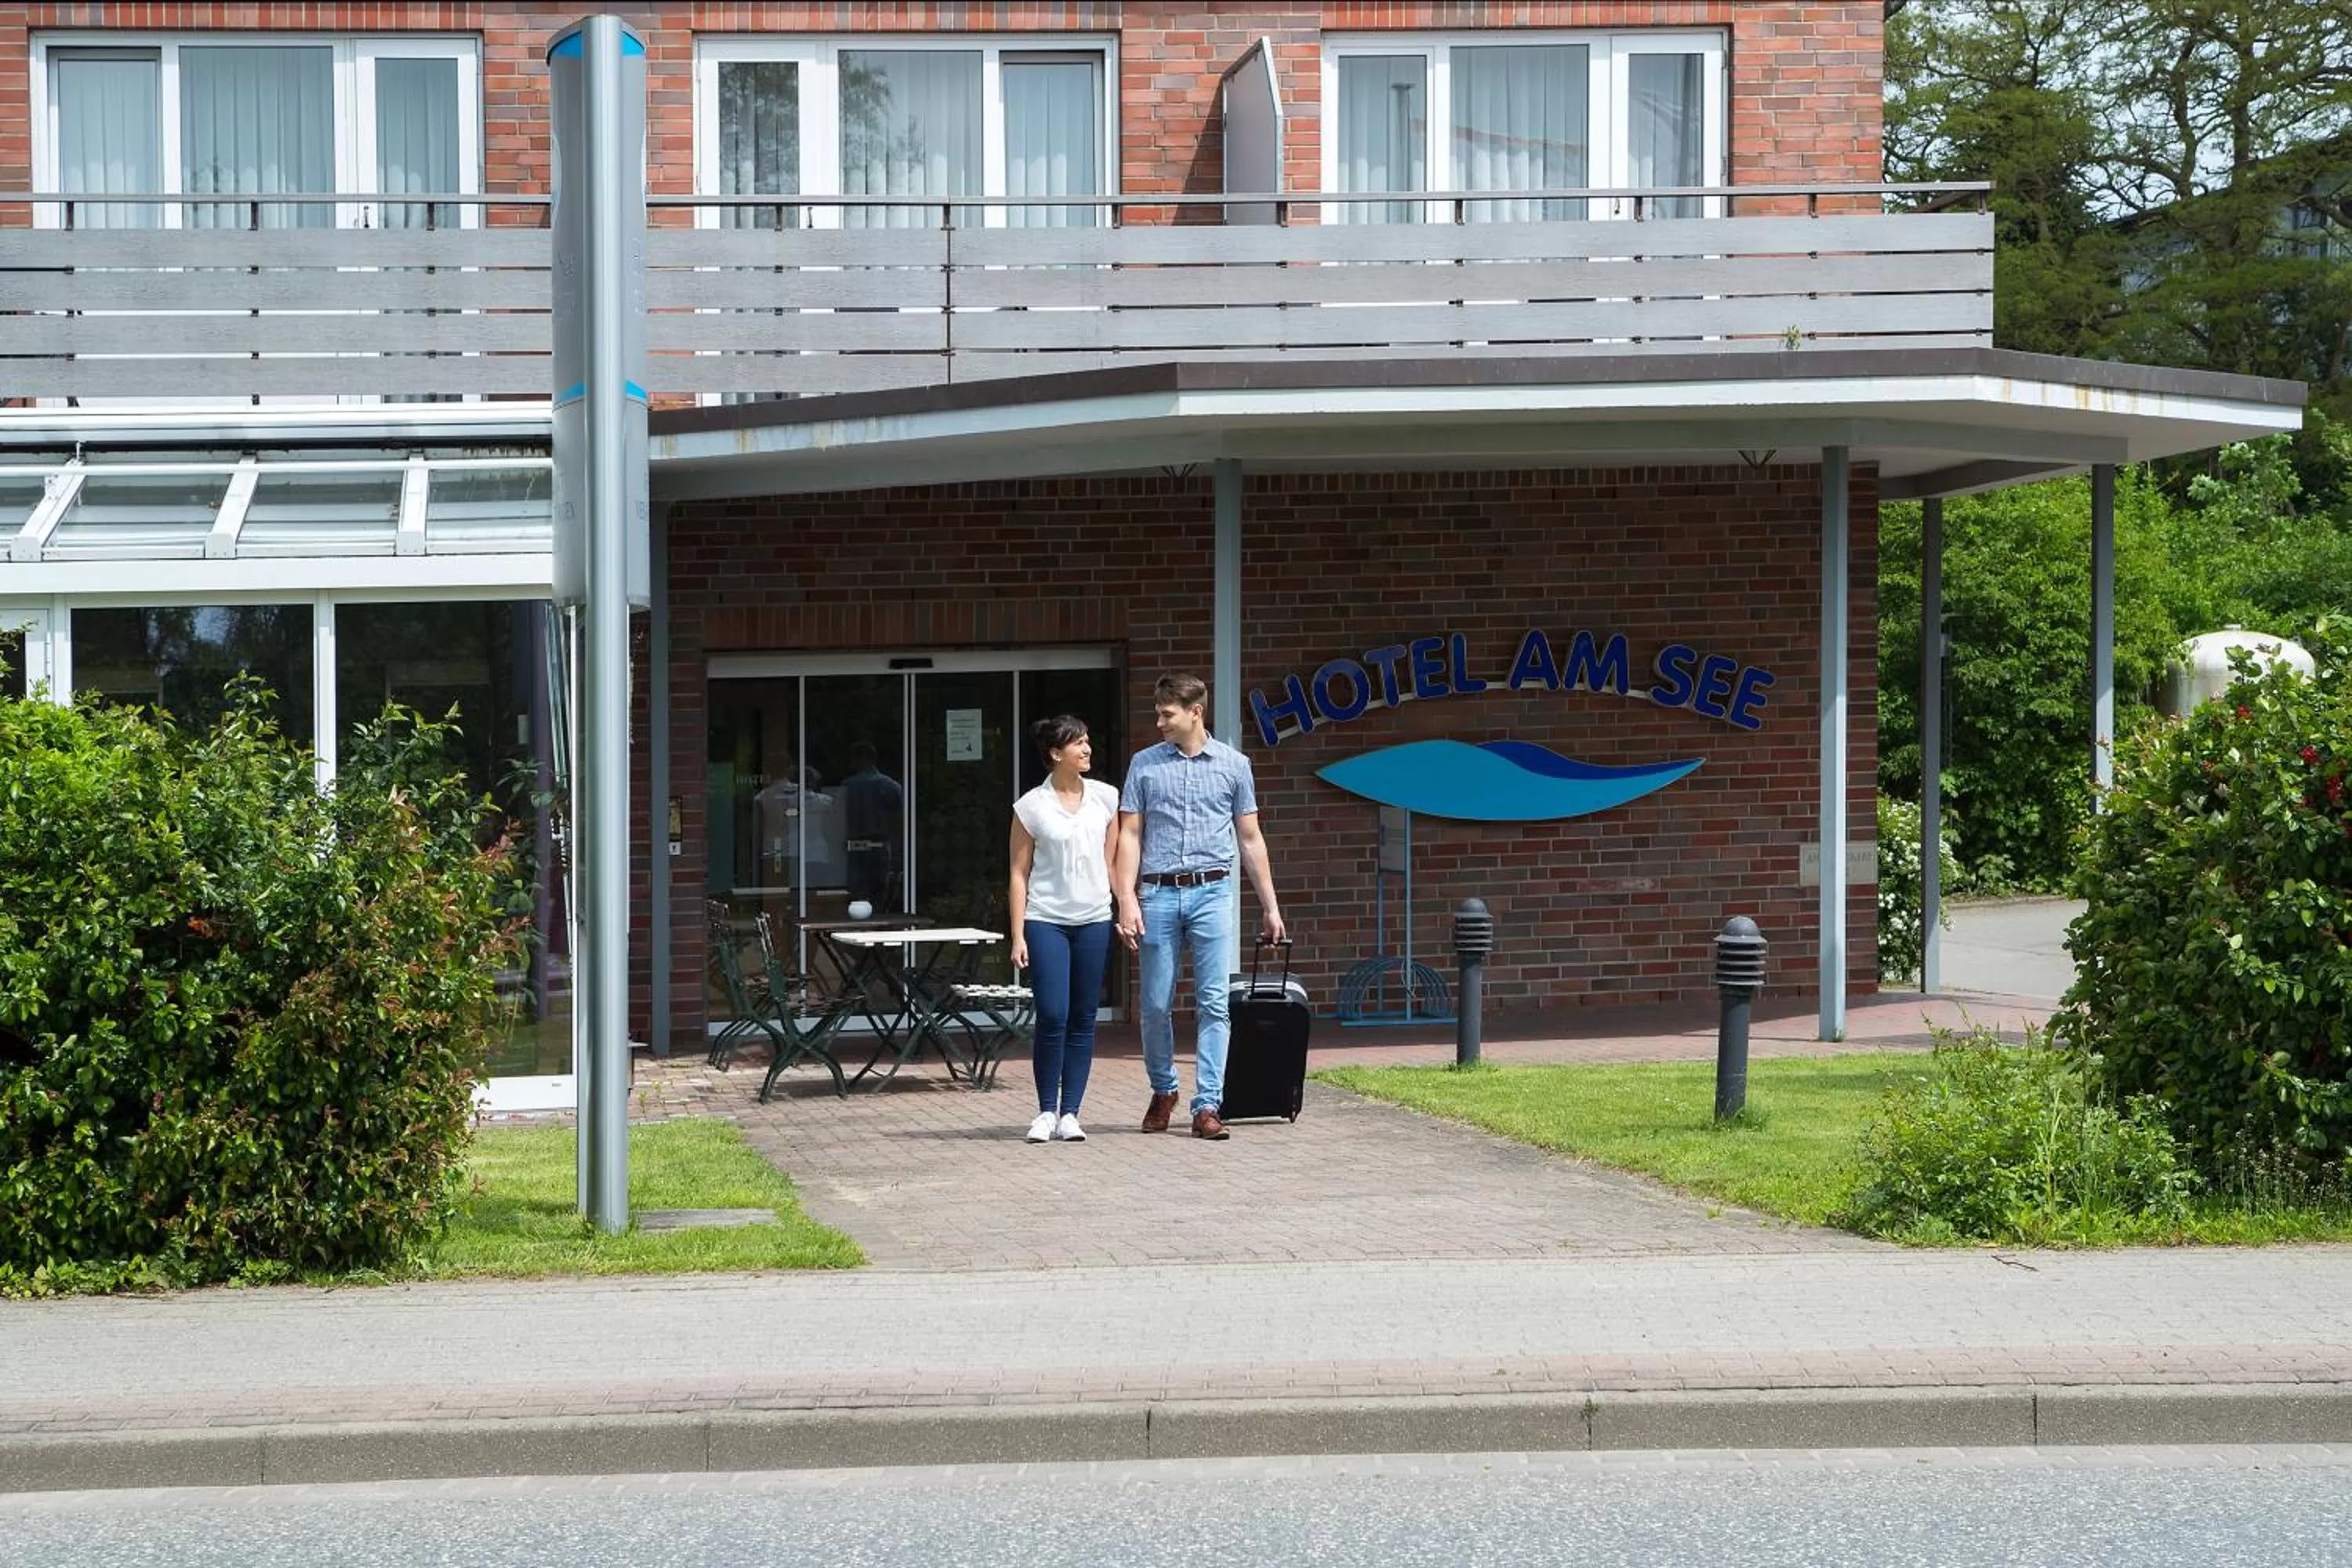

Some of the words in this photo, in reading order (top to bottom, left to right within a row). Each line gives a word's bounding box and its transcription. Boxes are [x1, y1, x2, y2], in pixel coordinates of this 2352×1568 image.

[1250, 632, 1488, 747] HOTEL
[1508, 629, 1629, 695] AM
[1649, 644, 1777, 730] SEE
